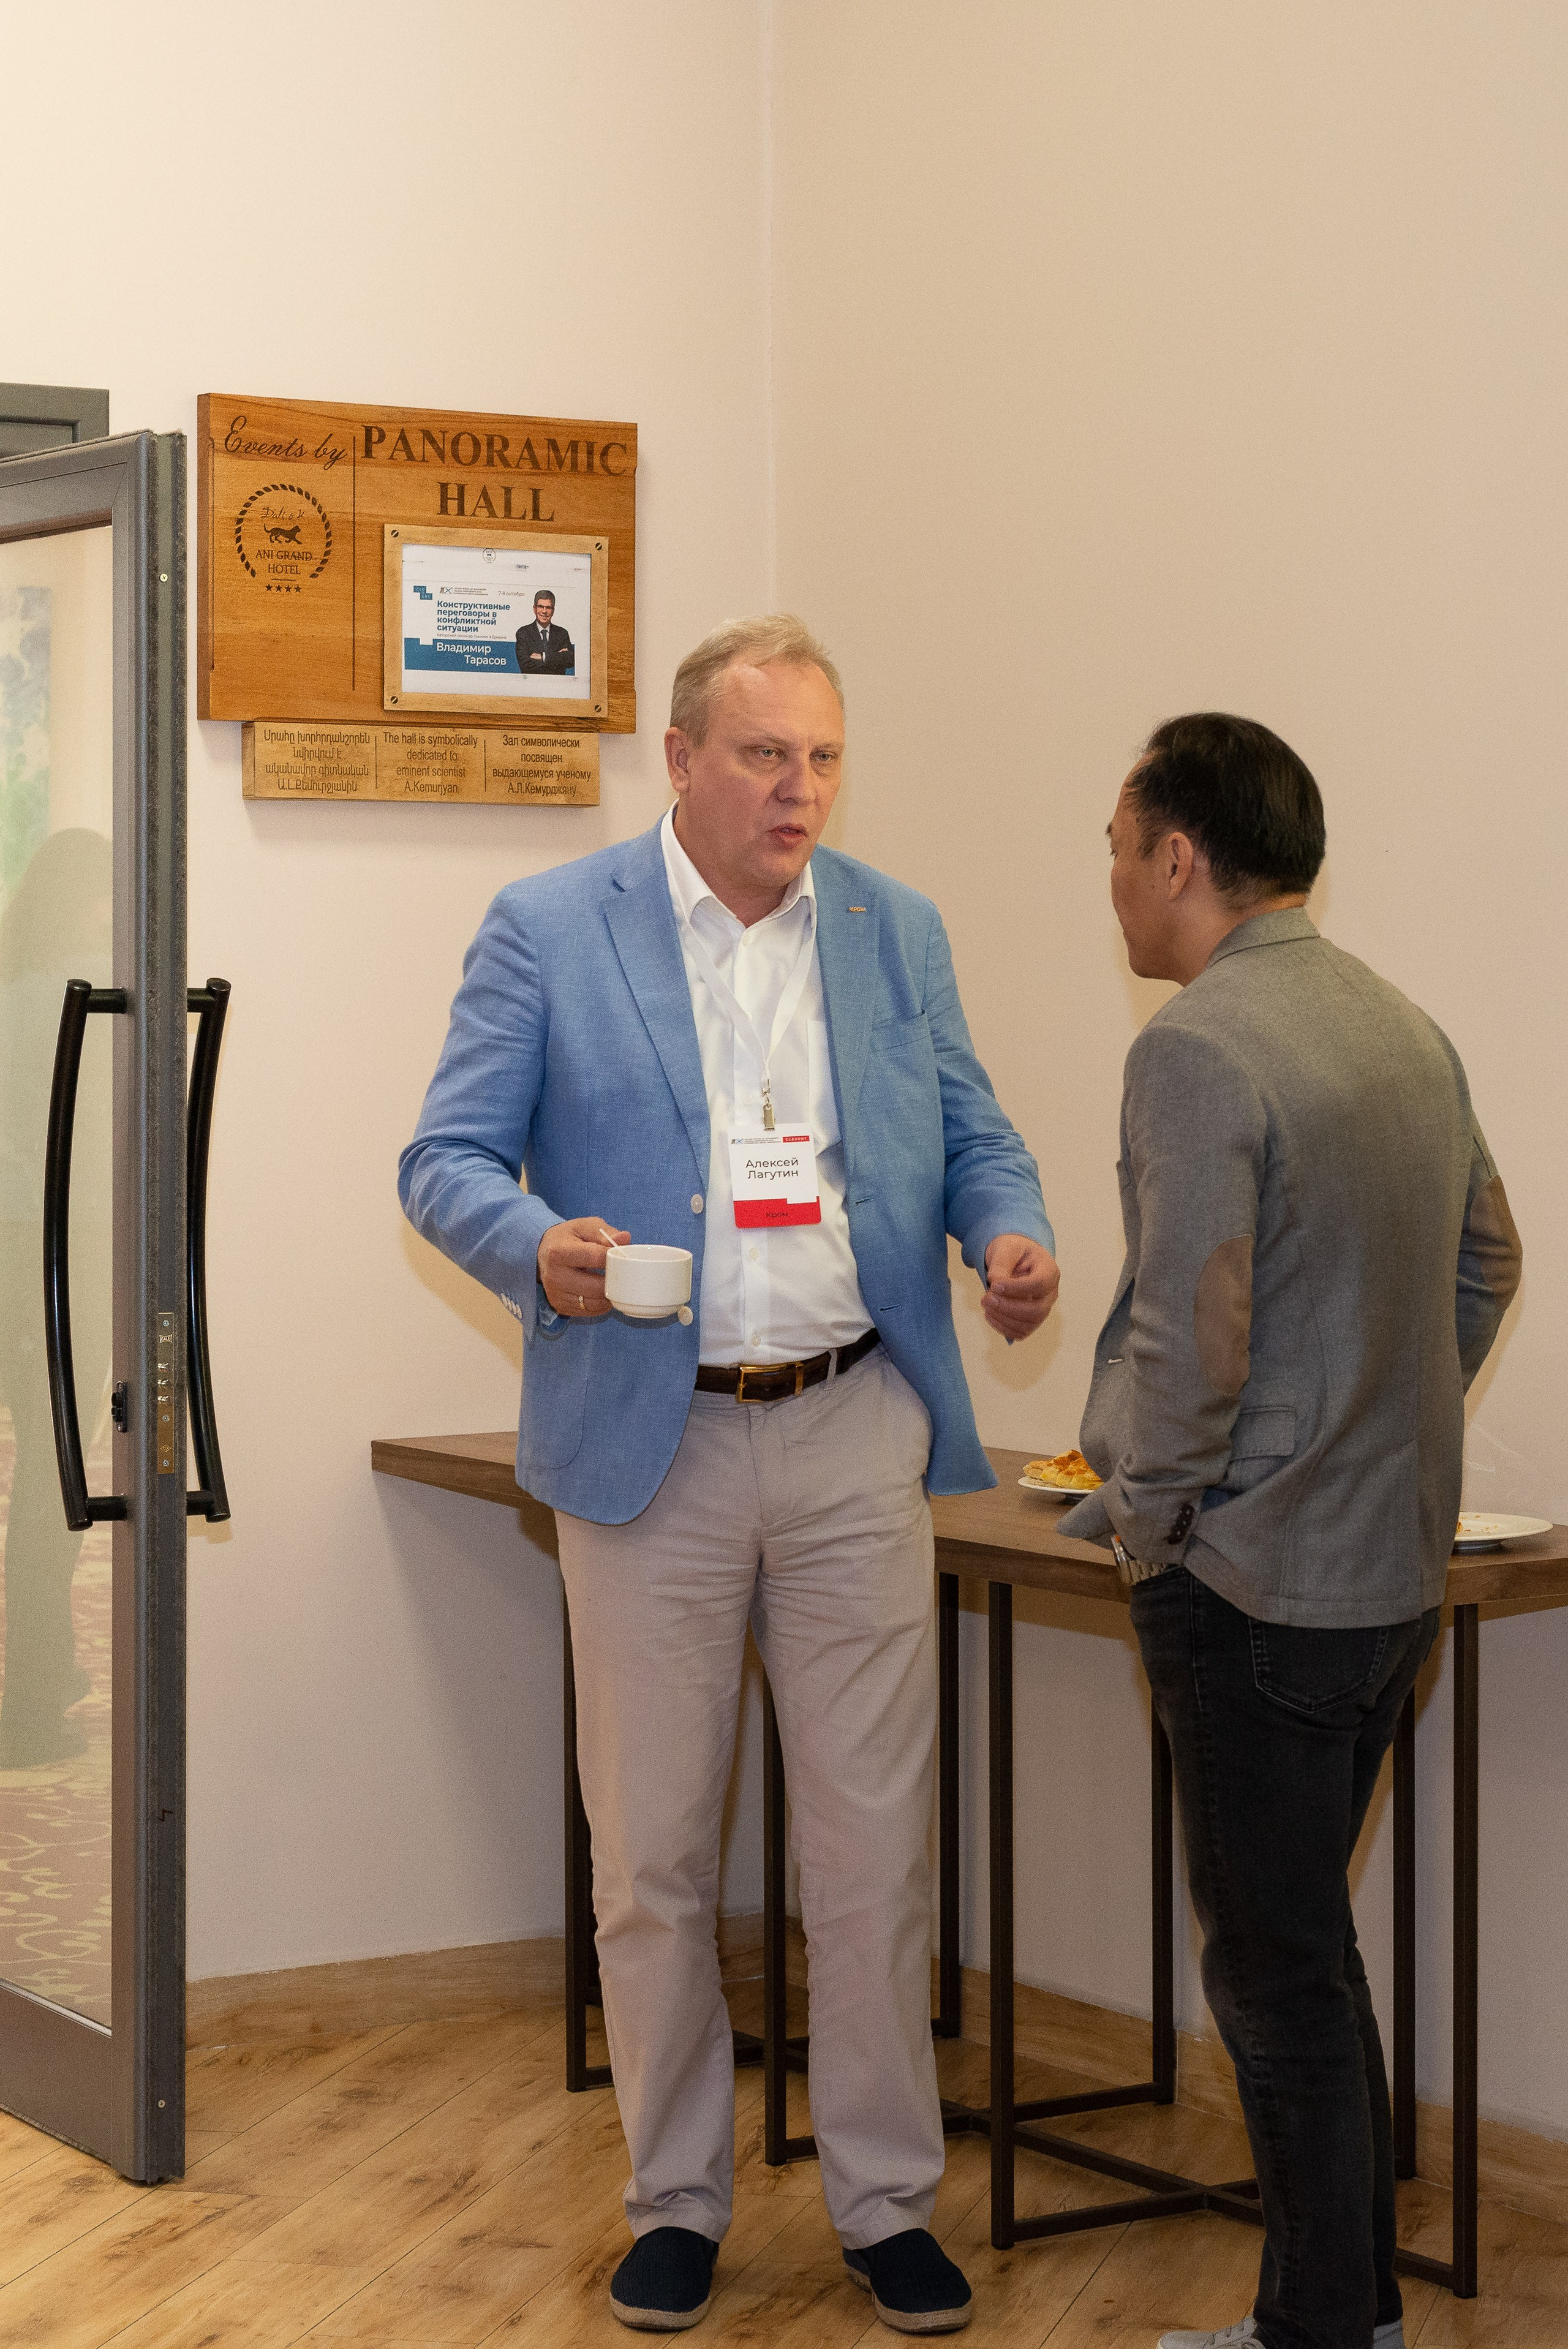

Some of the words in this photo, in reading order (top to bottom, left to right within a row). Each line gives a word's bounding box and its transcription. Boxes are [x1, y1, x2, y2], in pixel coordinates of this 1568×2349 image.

[224, 415, 307, 458] Events
[314, 433, 348, 470] by
[360, 424, 628, 477] PANORAMIC
[436, 481, 555, 522] HALL
[255, 549, 274, 559] ANI
[276, 550, 313, 561] GRAND
[268, 564, 301, 575] HOTEL
[437, 600, 510, 611] Конструктивные
[437, 616, 497, 625] конфликтной
[436, 642, 492, 655] Владимир
[464, 655, 507, 666] Тарасов
[383, 731, 399, 744] The
[401, 733, 417, 744] hall
[418, 733, 426, 744] is
[428, 734, 478, 748] symbolically
[502, 734, 519, 746] Зал
[521, 737, 580, 748] символически
[407, 748, 447, 761] dedicated
[449, 750, 458, 761] to
[521, 753, 562, 764] посвящен
[396, 766, 429, 777] eminent
[431, 765, 466, 777] scientist
[492, 768, 554, 781] выдающемуся
[556, 769, 592, 782] ученому
[404, 780, 458, 795] A.Kemurjyan
[507, 782, 577, 797] А.Л.Кемурджяну
[745, 1157, 799, 1169] Алексей
[747, 1170, 799, 1180] Лагутин
